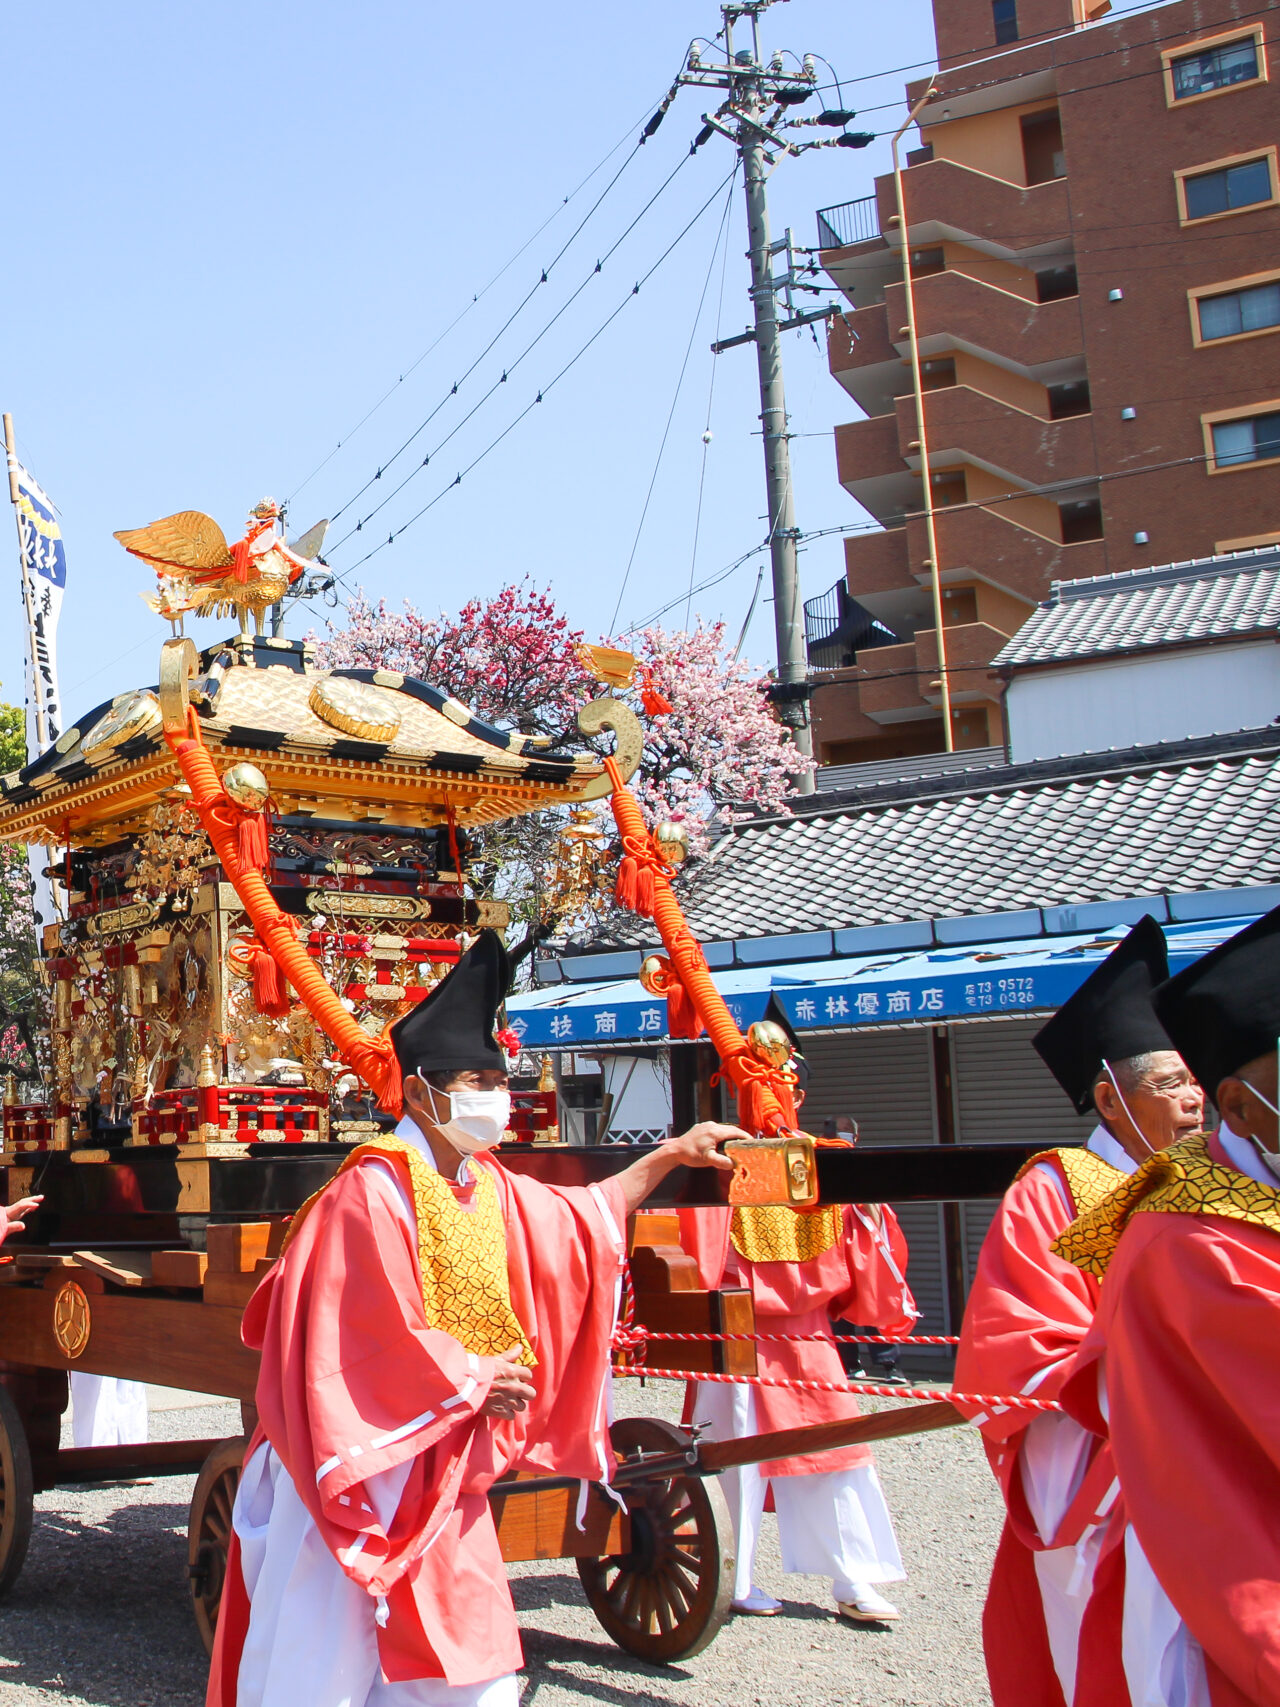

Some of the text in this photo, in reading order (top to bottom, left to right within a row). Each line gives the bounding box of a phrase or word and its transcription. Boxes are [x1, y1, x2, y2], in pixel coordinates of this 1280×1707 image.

[794, 987, 945, 1021] 赤林優商店
[509, 1007, 662, 1040] 今枝商店
